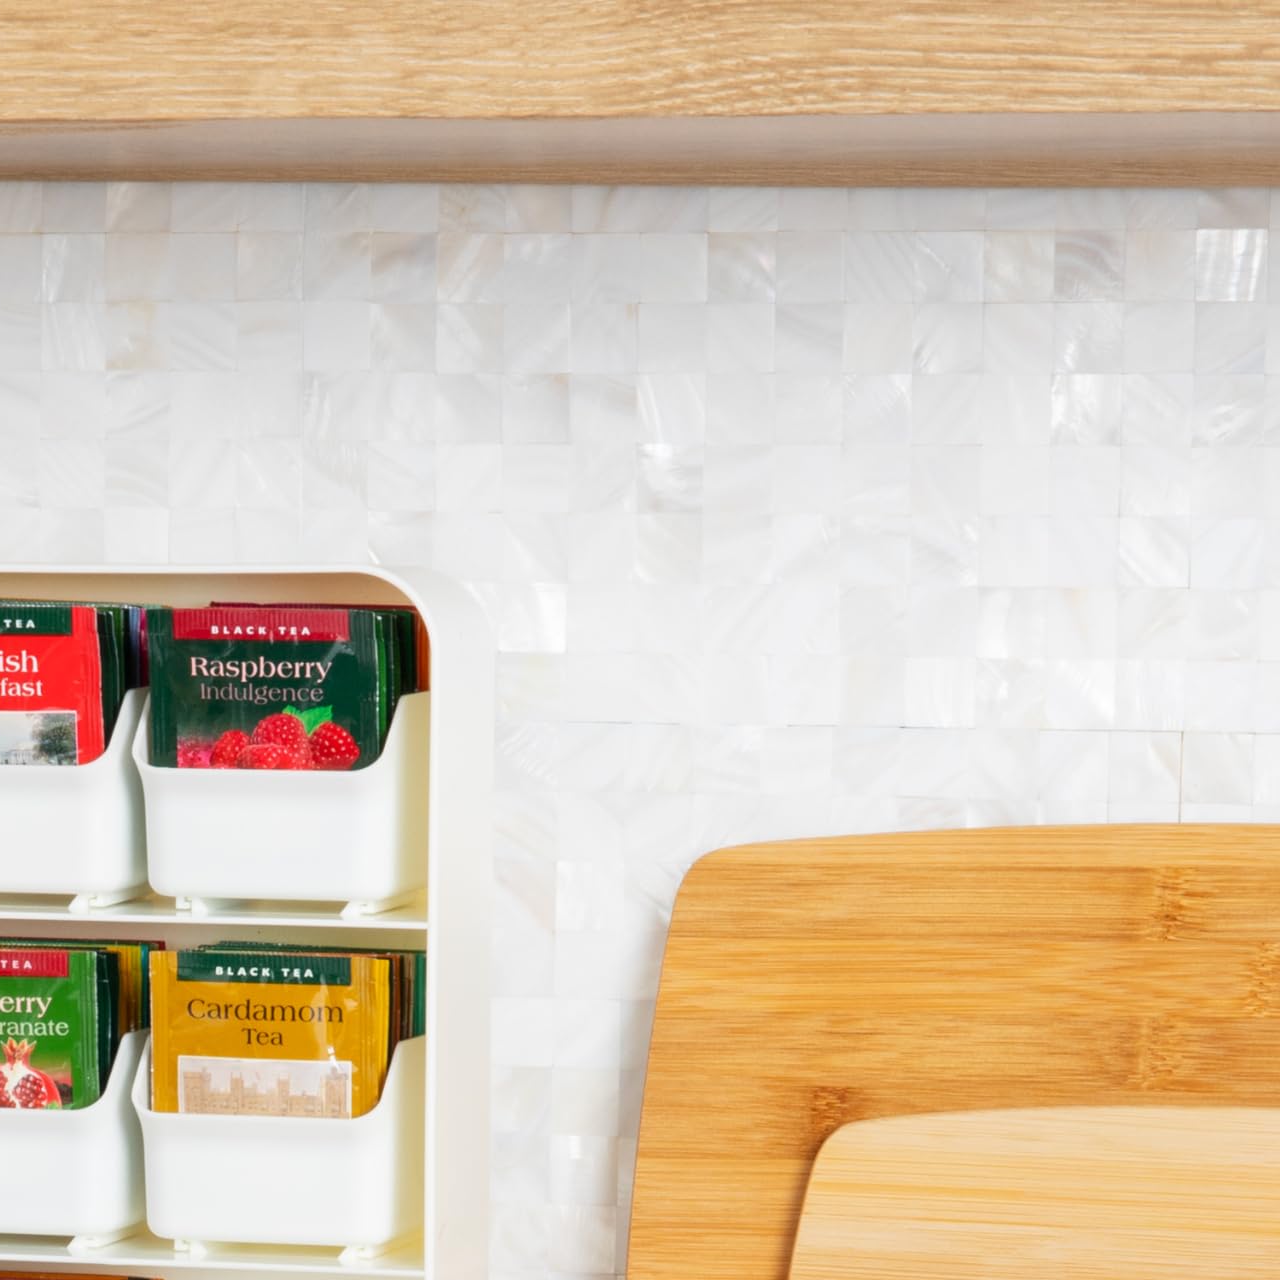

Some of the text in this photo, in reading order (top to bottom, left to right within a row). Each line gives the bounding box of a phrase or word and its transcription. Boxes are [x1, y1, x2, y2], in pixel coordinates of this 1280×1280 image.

[3, 619, 36, 629] TEA
[210, 625, 312, 636] BLACK TEA
[190, 656, 332, 683] Raspberry
[200, 682, 324, 705] Indulgence
[0, 959, 33, 970] TEA
[215, 966, 314, 978] BLACK TEA
[186, 998, 344, 1024] Cardamom
[241, 1028, 284, 1046] Tea
